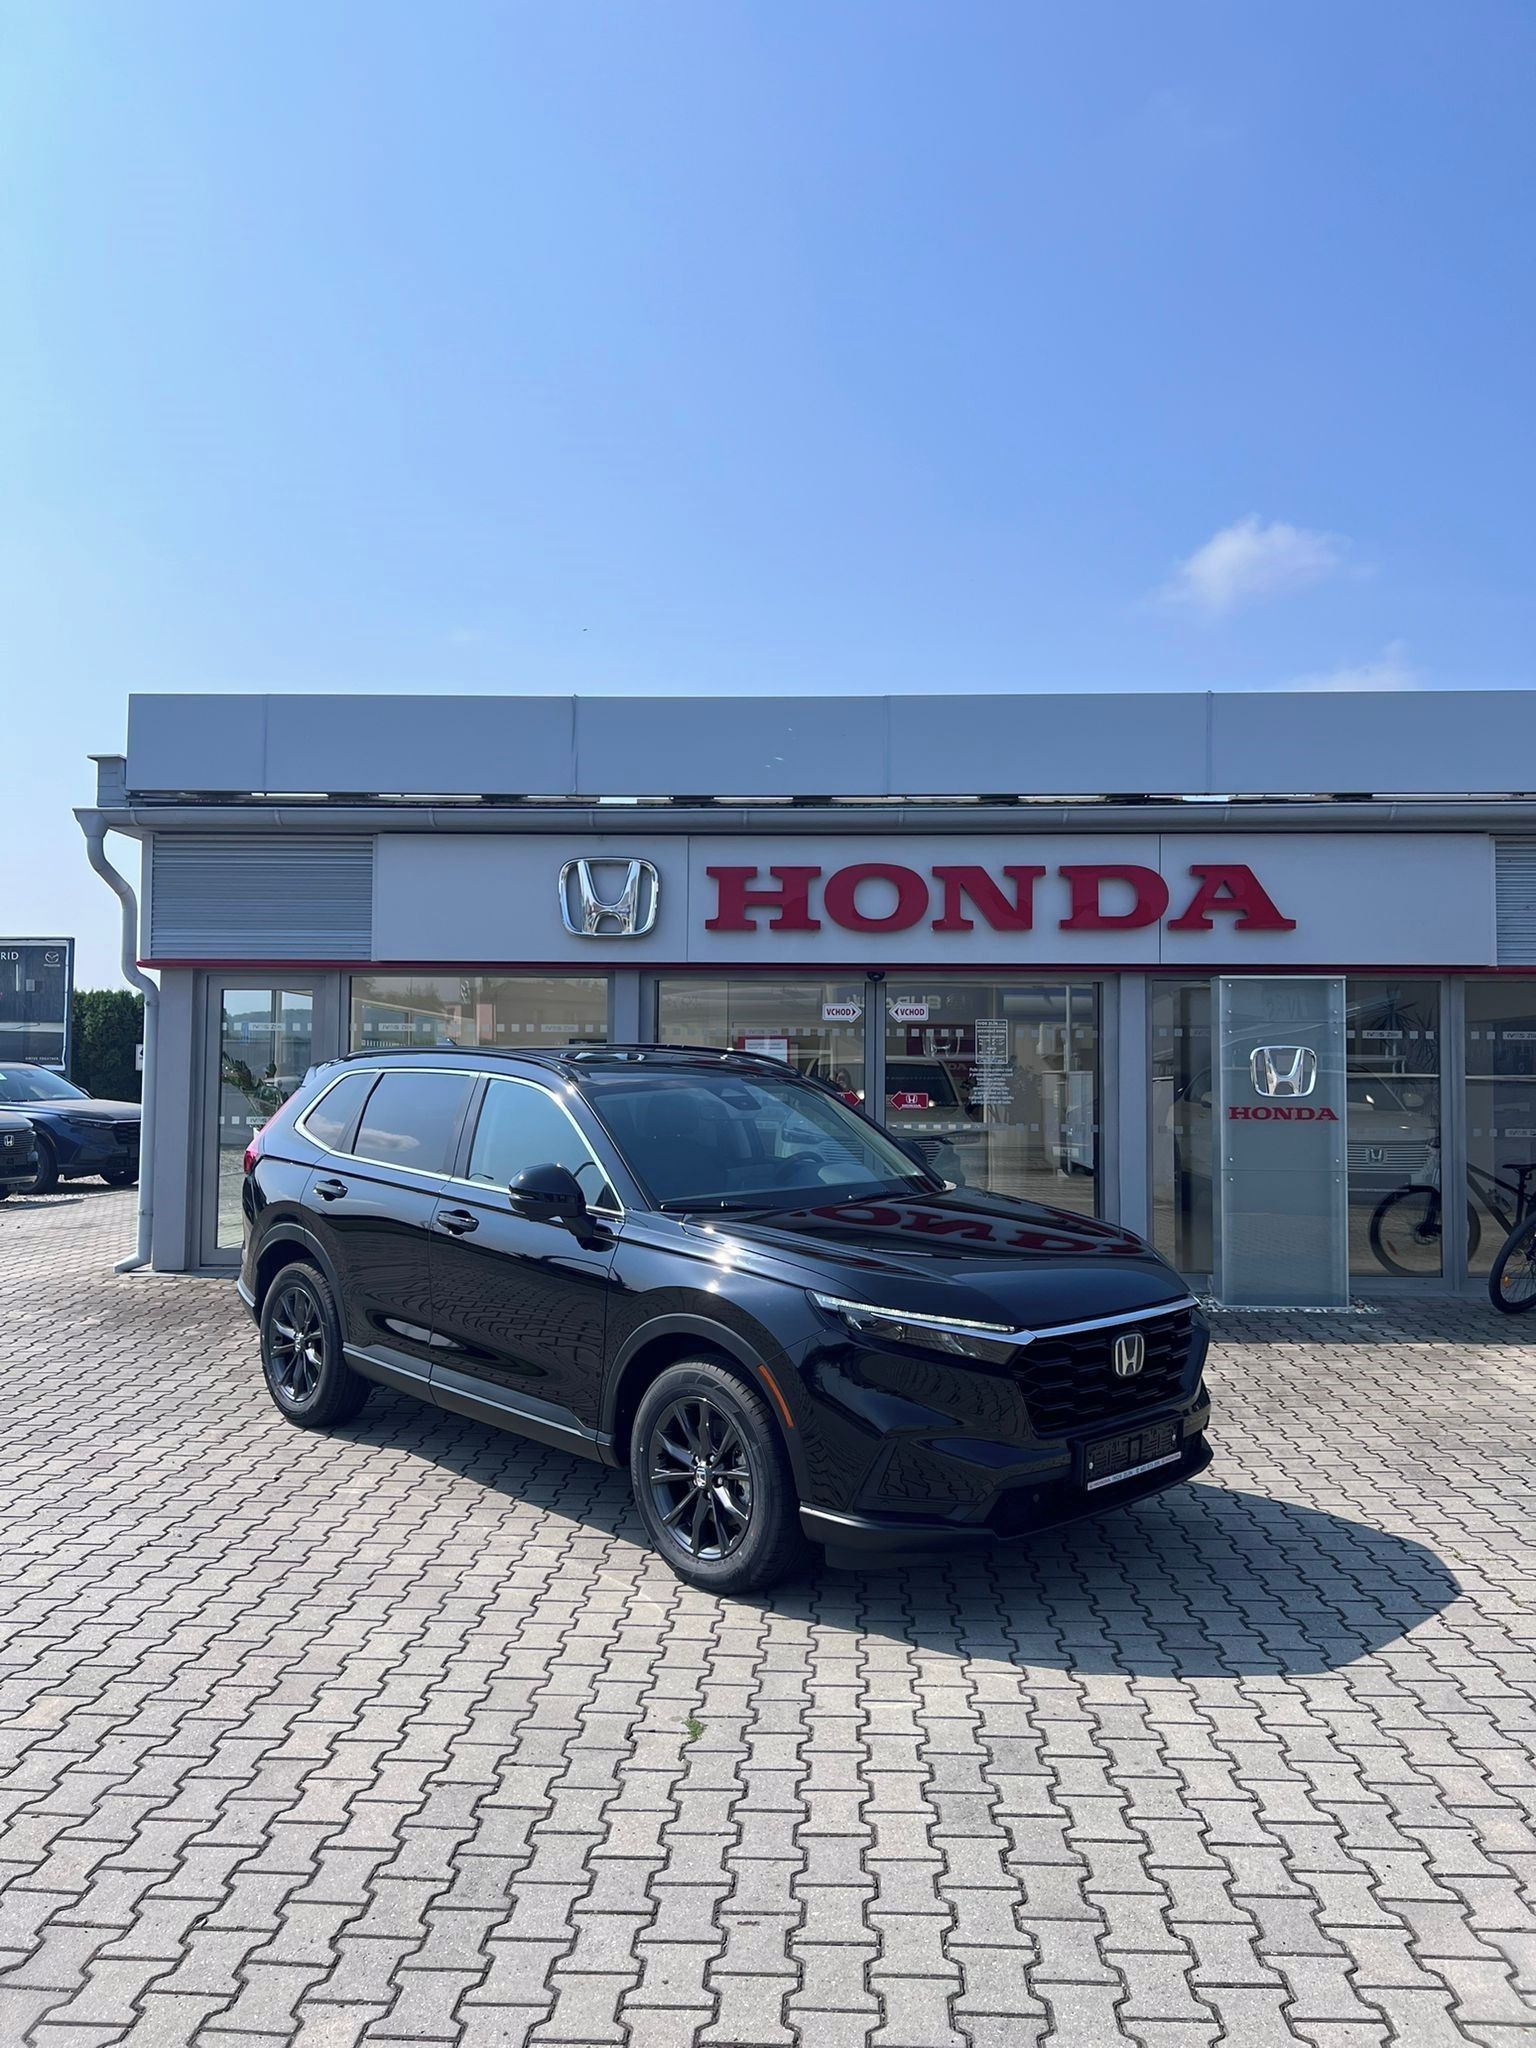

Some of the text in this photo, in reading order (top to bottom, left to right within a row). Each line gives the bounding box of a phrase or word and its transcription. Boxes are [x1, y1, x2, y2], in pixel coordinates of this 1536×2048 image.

[705, 863, 1297, 932] HONDA
[826, 1007, 851, 1016] VCHOD
[900, 1007, 925, 1016] VCHOD
[1228, 1106, 1339, 1121] HONDA
